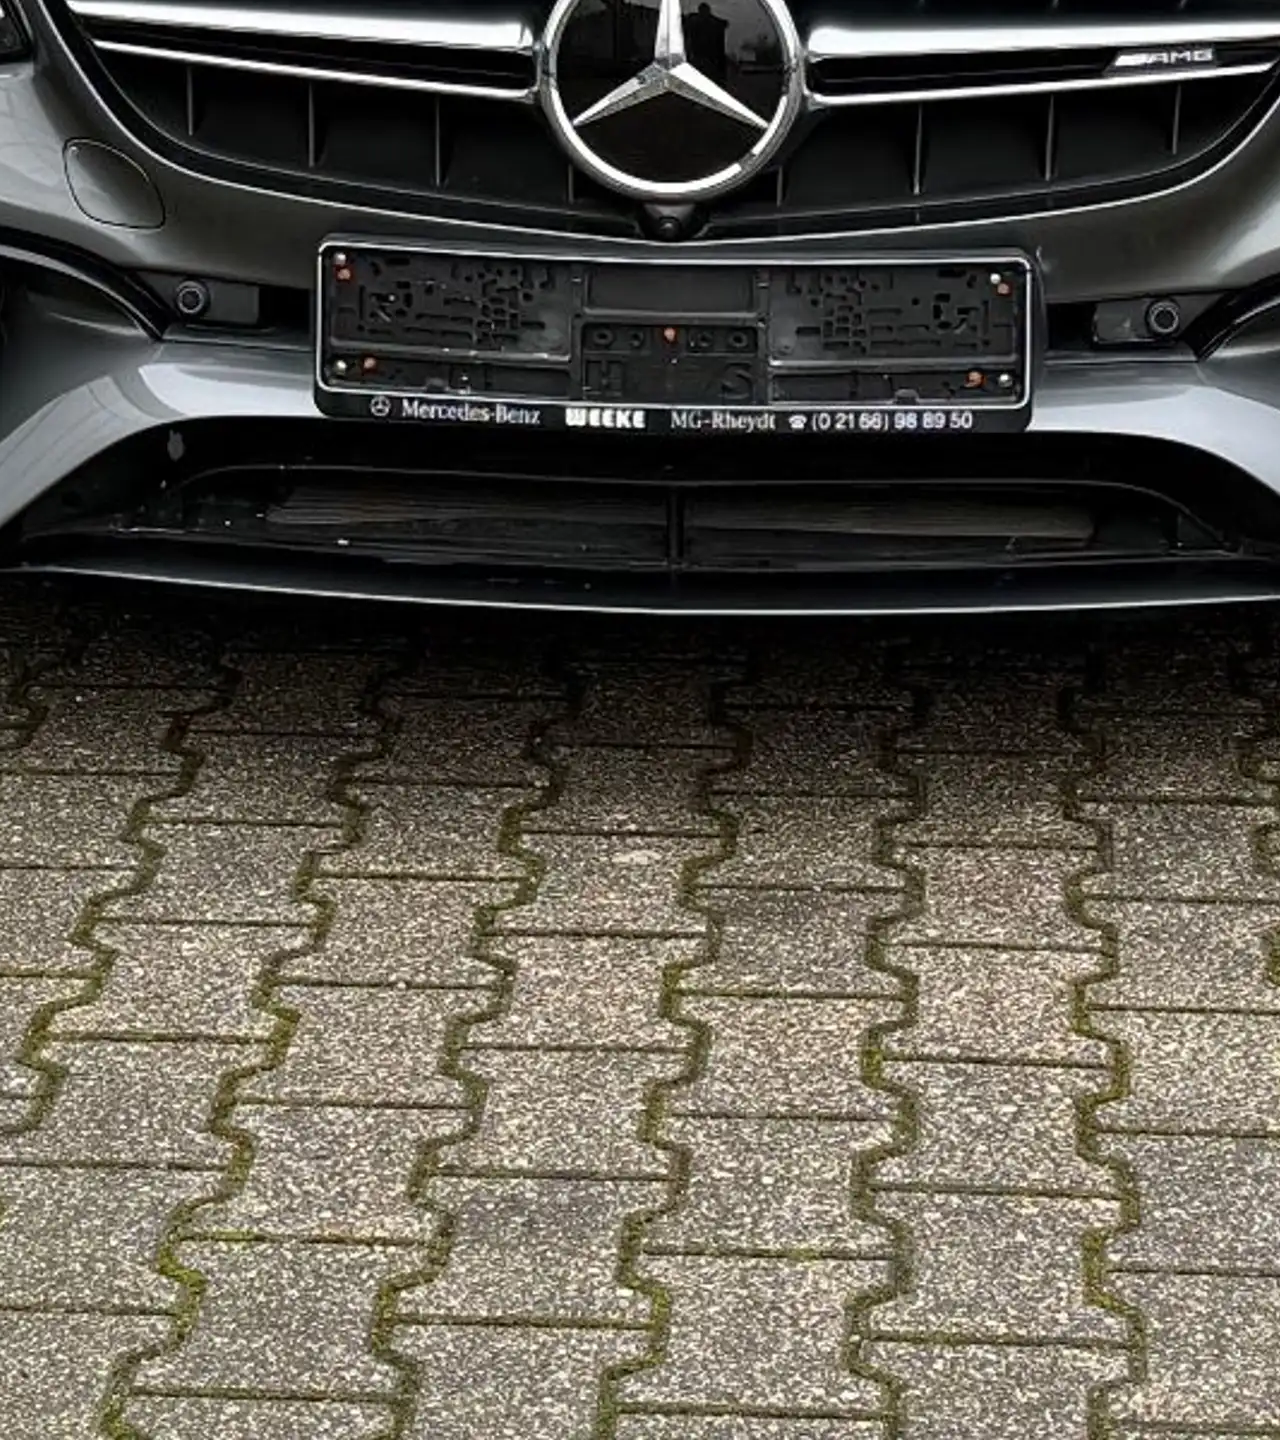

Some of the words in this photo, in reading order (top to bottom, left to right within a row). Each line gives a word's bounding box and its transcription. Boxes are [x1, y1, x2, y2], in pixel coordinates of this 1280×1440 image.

[1146, 48, 1213, 64] AMG
[401, 398, 541, 424] Mercedes-Benz
[565, 407, 646, 429] WEEKE
[670, 409, 776, 434] MG-Rheydt
[811, 412, 831, 431] (0
[835, 412, 855, 429] 21
[894, 411, 918, 429] 98
[922, 411, 946, 429] 89
[949, 411, 973, 429] 50
